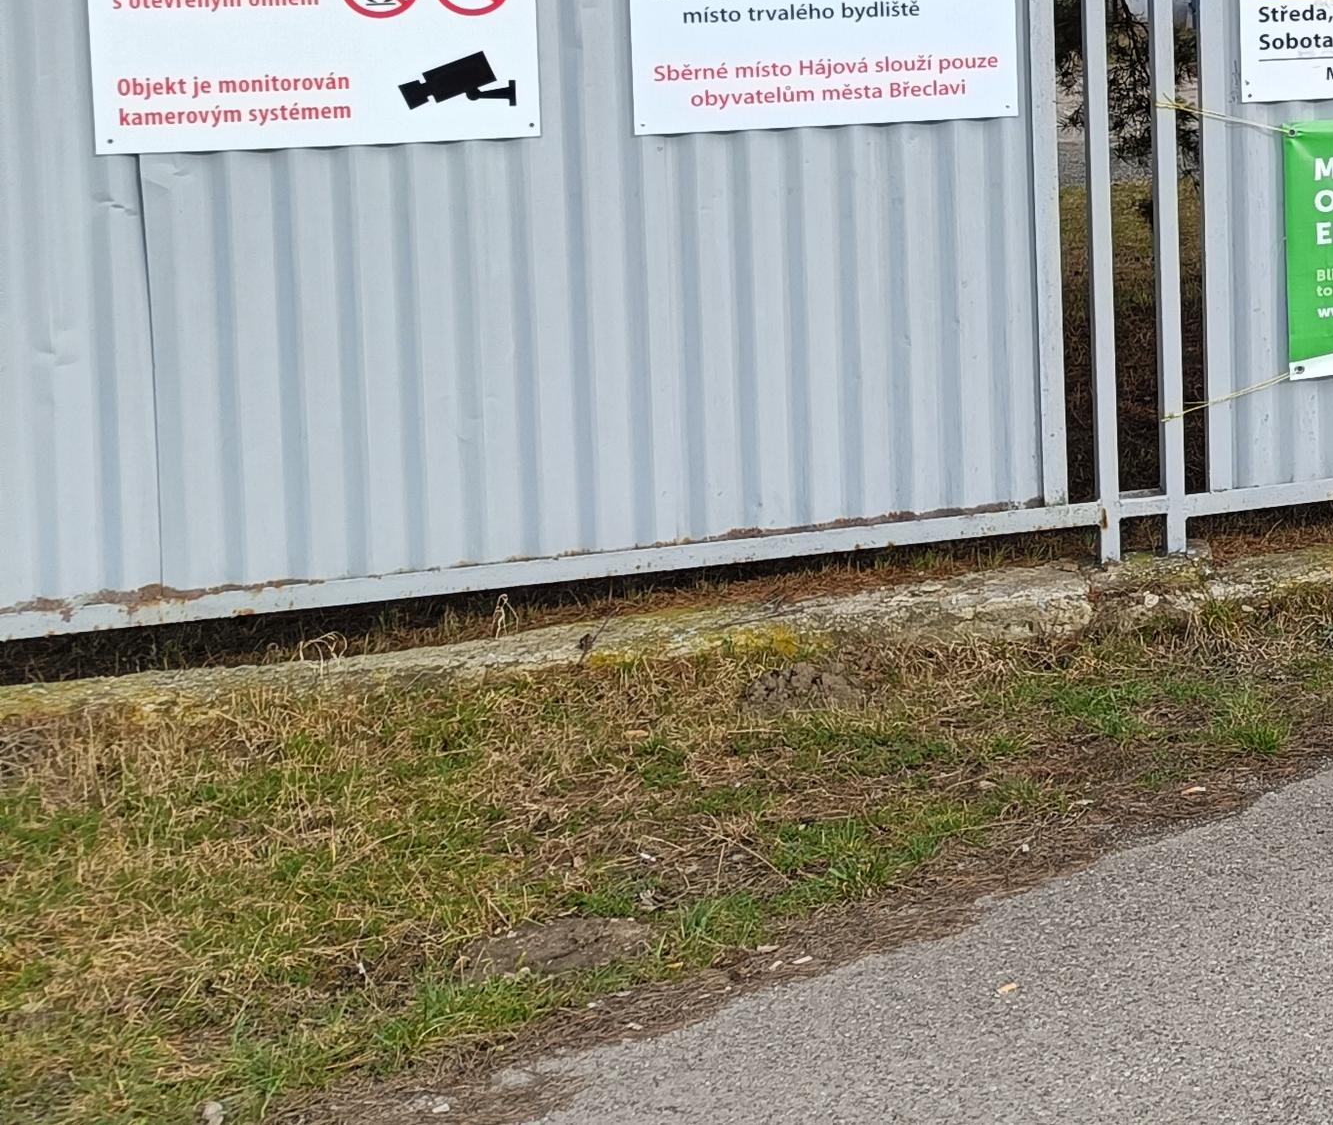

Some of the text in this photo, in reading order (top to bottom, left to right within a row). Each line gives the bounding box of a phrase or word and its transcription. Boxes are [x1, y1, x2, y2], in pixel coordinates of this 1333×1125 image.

[683, 1, 919, 23] místo trvalého bydliště
[1259, 4, 1333, 22] Středa,
[1260, 33, 1333, 50] Sobota
[654, 54, 998, 81] Sběrné místo Hájová slouží pouze
[118, 72, 349, 100] Objekt je monitorován
[691, 79, 965, 110] obyvatelům města Břeclavi
[119, 102, 351, 127] kamerovým systémem
